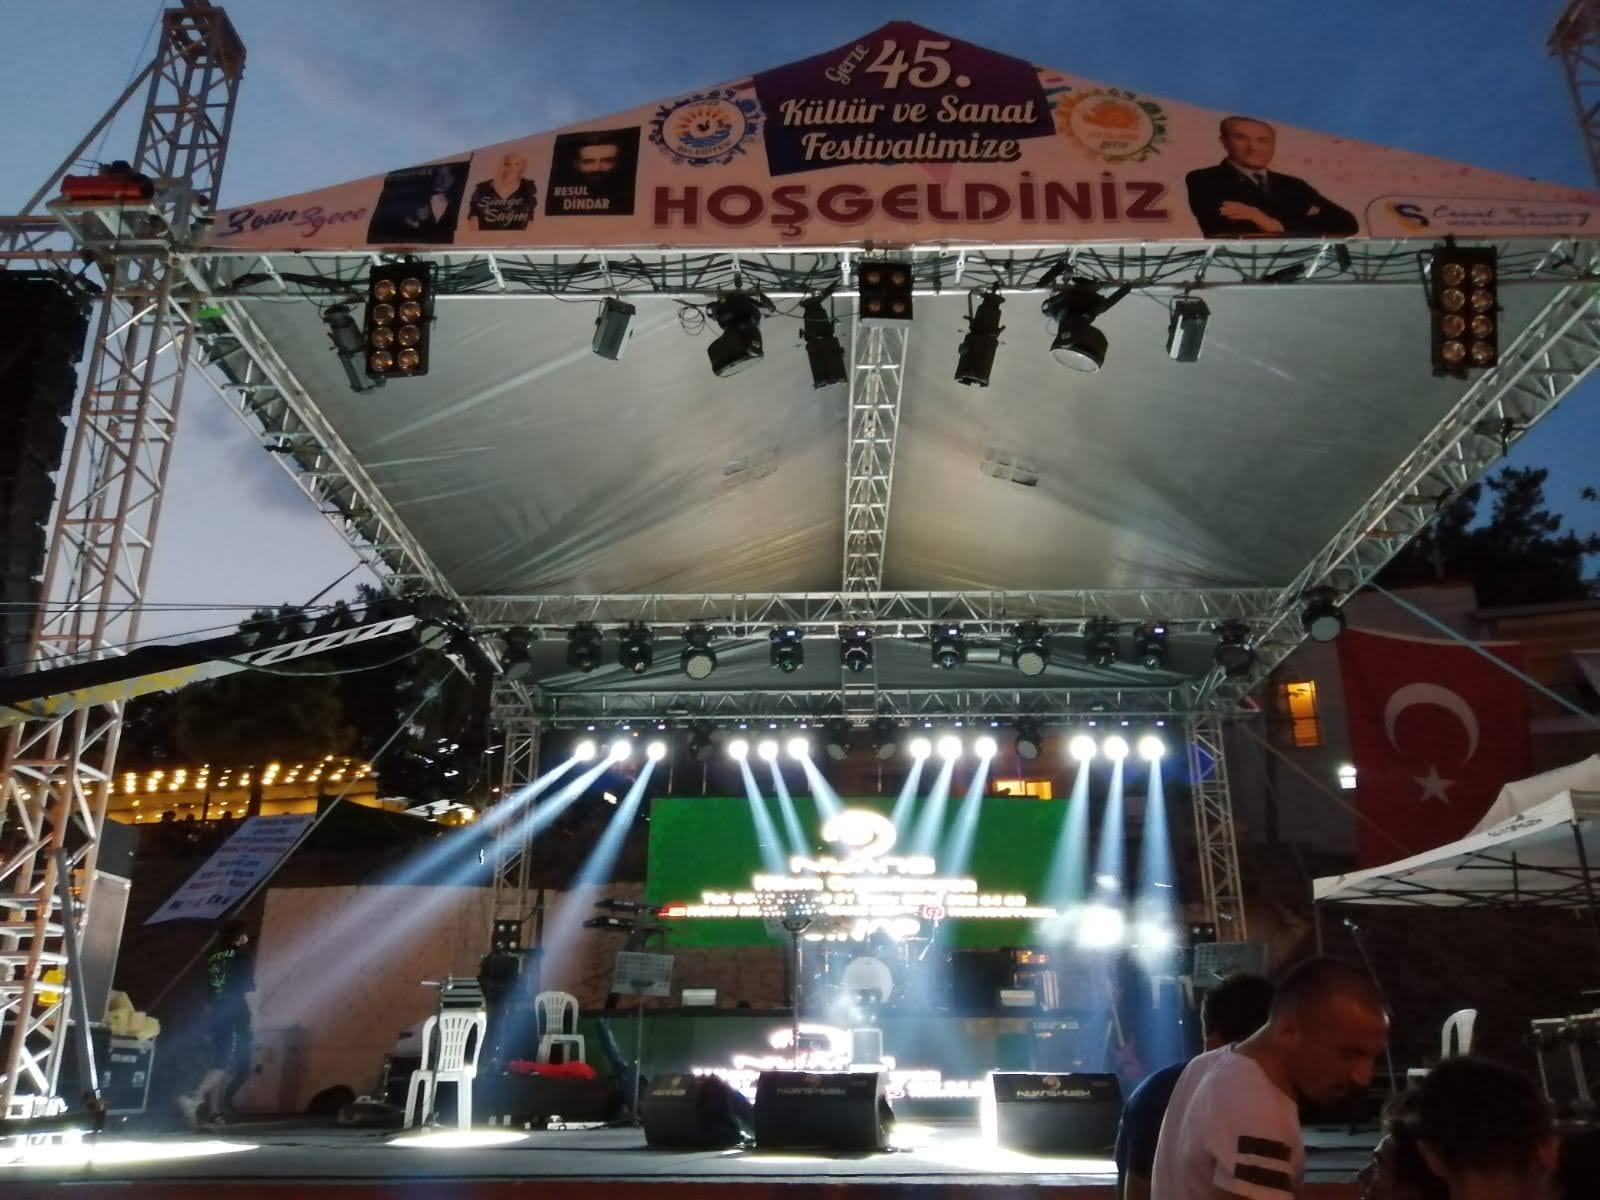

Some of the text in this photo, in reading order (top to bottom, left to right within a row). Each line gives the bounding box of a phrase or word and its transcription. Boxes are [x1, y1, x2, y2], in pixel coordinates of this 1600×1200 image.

[825, 39, 972, 89] Gerze 45.
[780, 95, 1038, 126] Kültür ve Sanat
[801, 132, 1020, 161] Festivalimize
[554, 186, 589, 196] RESUL
[563, 197, 610, 210] DİNDAR
[654, 171, 1169, 237] HOŞGELDİNİZ
